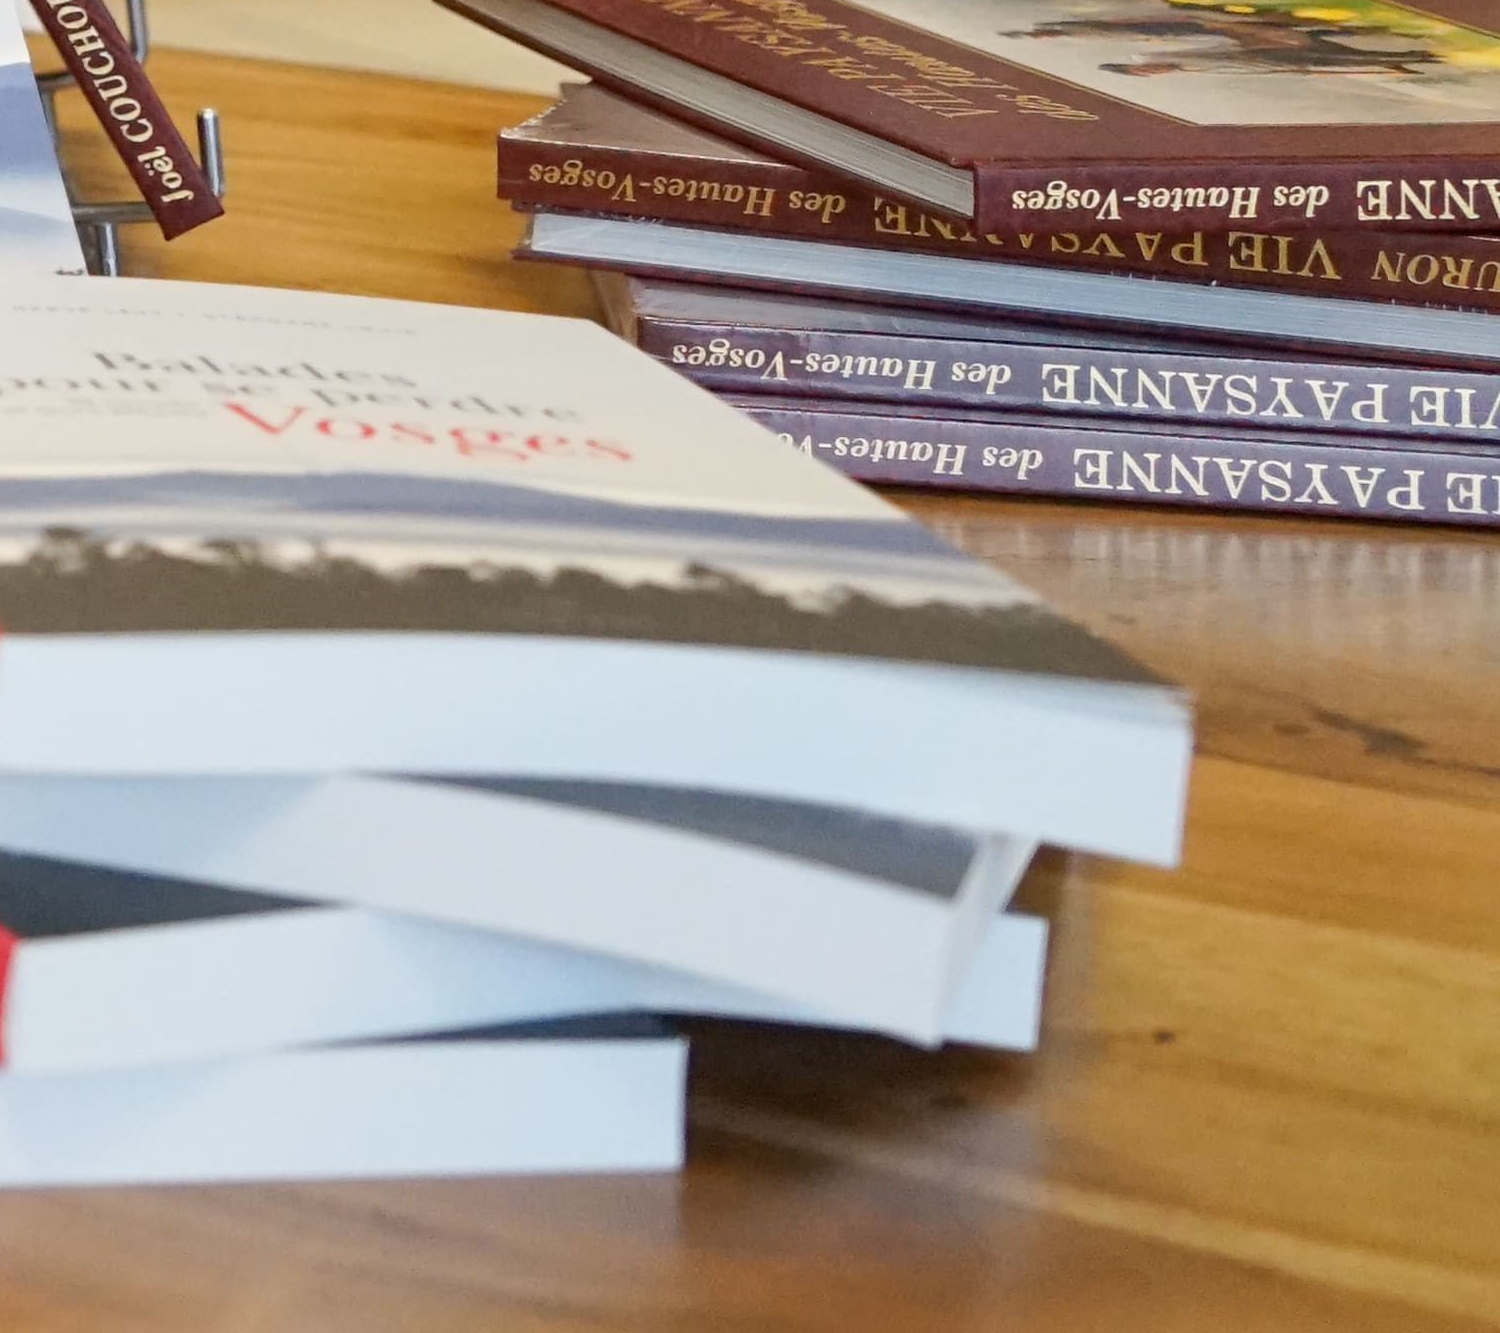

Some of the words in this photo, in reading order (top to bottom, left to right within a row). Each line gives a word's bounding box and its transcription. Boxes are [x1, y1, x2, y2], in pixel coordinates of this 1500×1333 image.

[138, 144, 194, 204] Joël
[529, 159, 777, 217] Hautes-Vosges
[789, 190, 847, 224] des
[1011, 179, 1259, 220] Hautes-Vosges
[1273, 185, 1330, 218] des
[1229, 231, 1343, 280] VIE
[672, 338, 937, 390] Hautes-Vosges
[951, 362, 1012, 395] des
[1041, 362, 1389, 424] PAYSANNE
[223, 400, 632, 462] Vosges
[982, 446, 1043, 481] des
[1073, 448, 1425, 511] PAYSANNE
